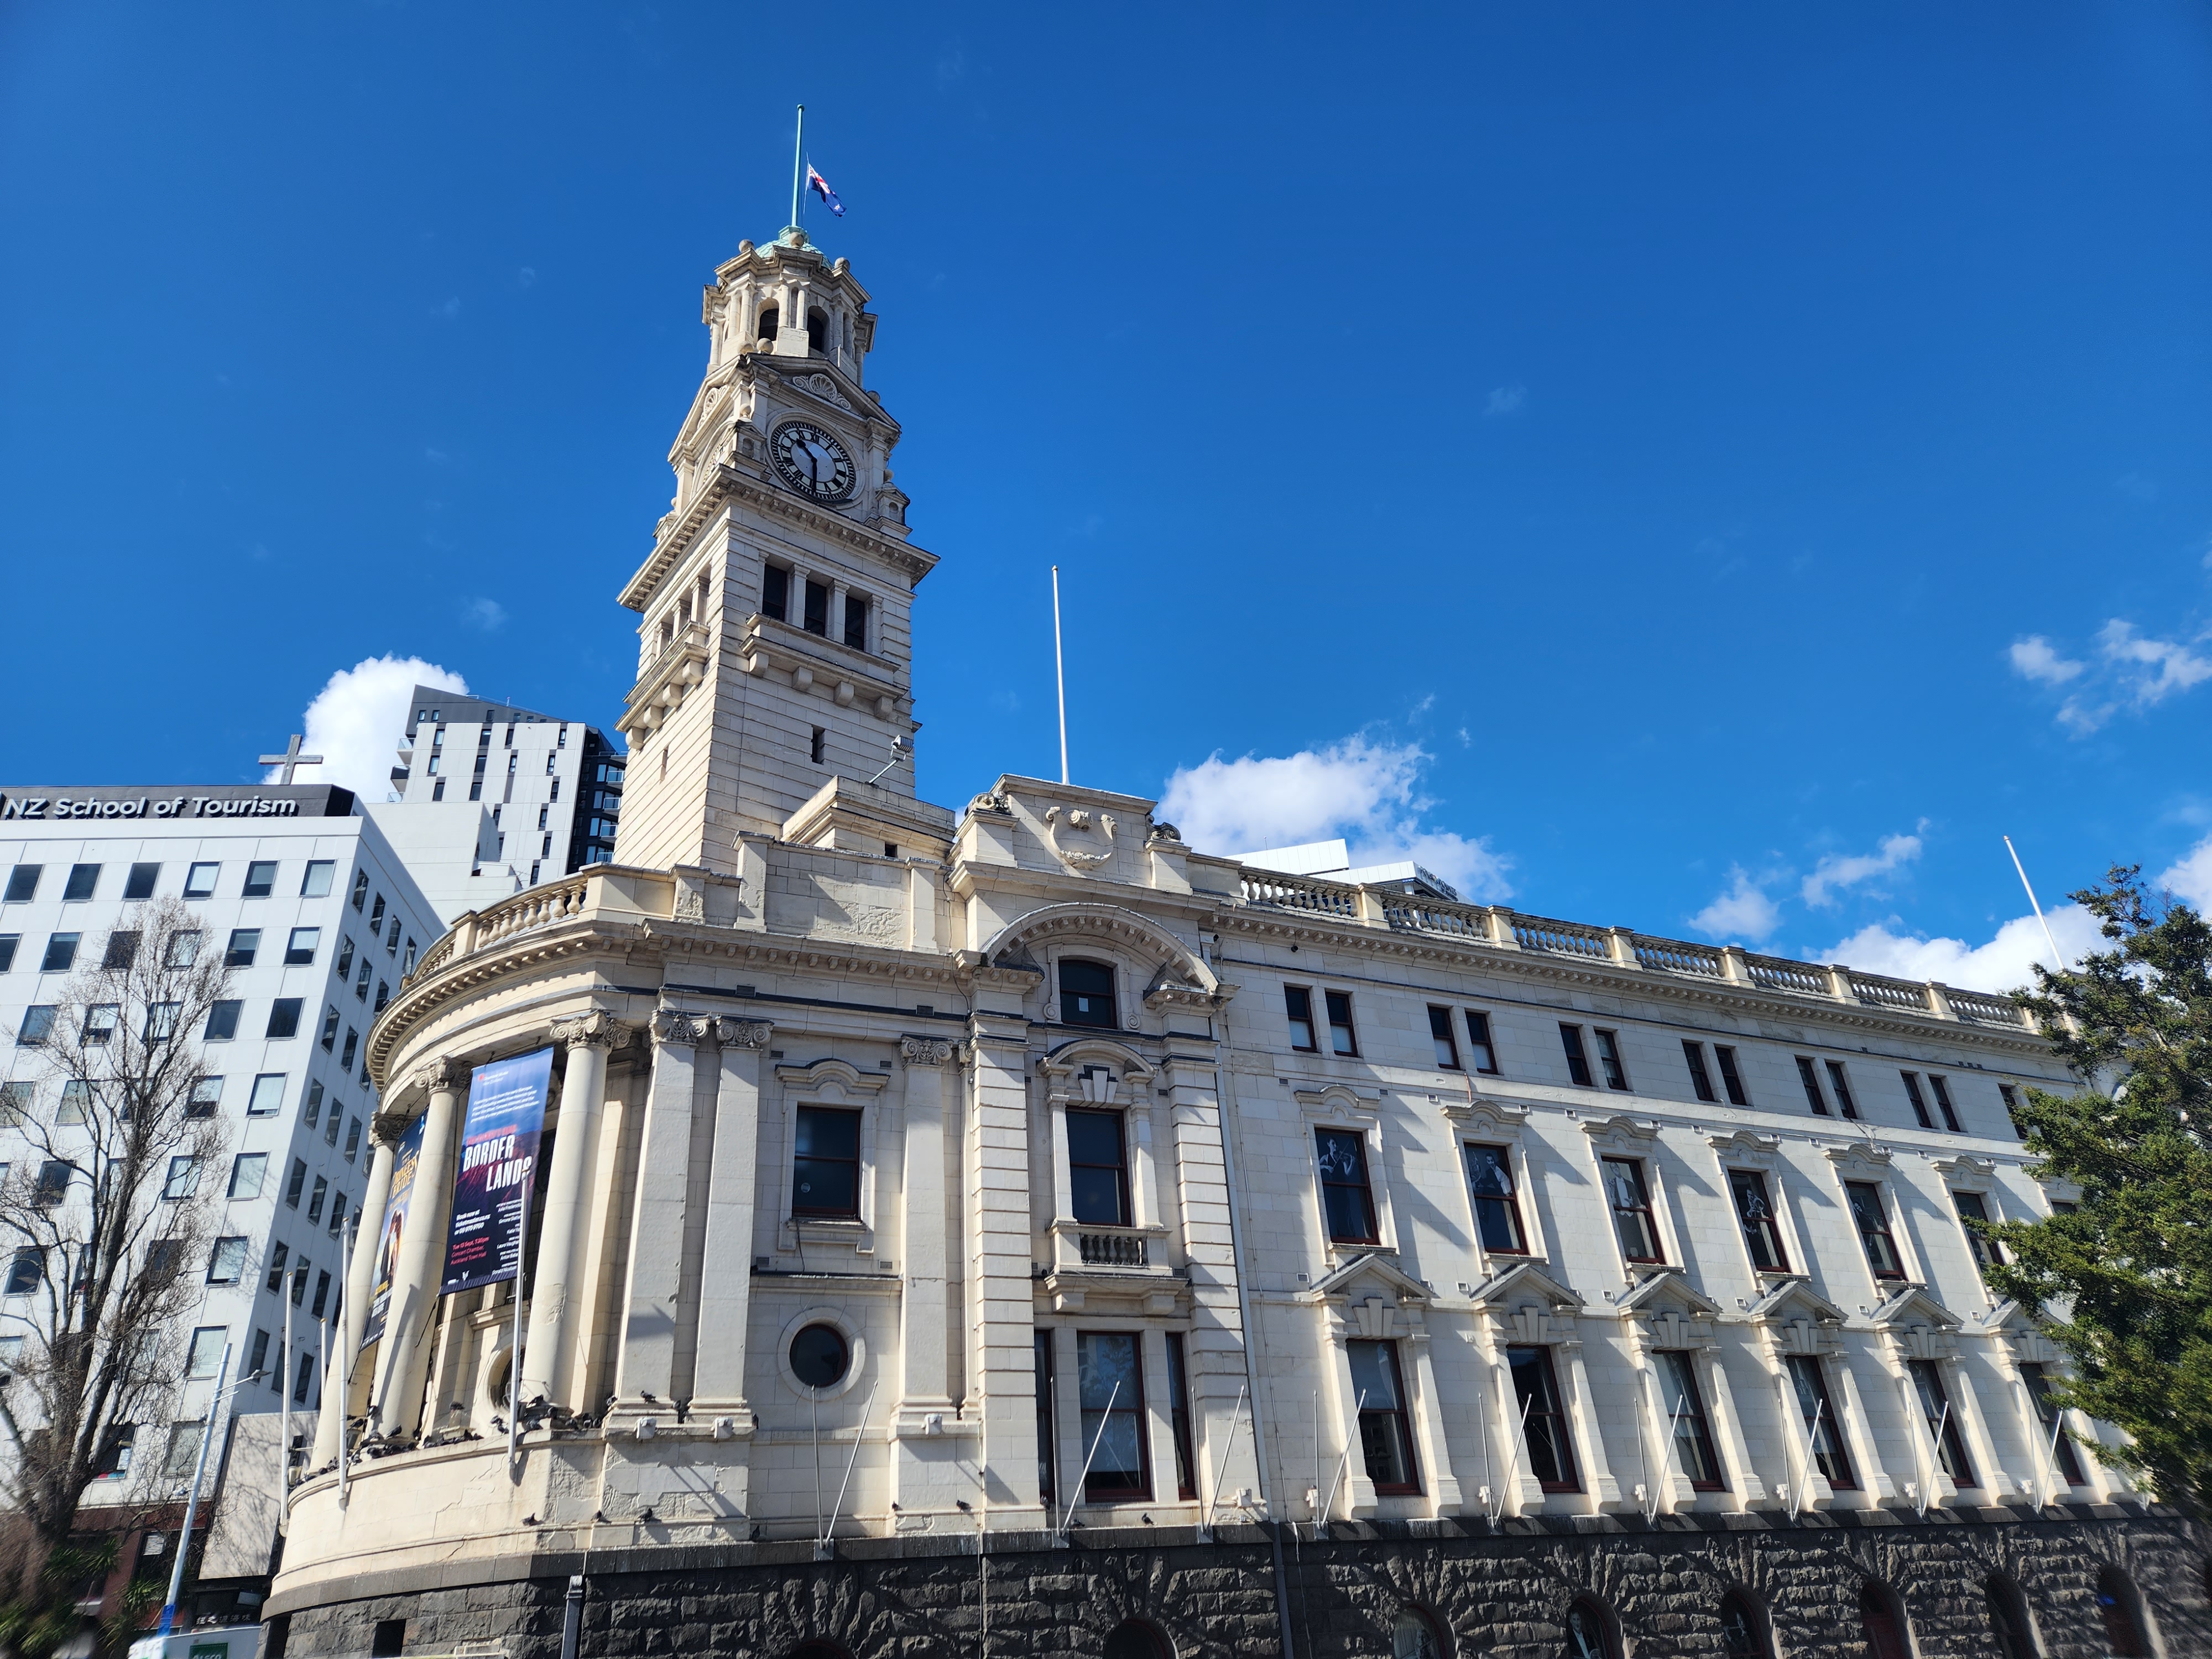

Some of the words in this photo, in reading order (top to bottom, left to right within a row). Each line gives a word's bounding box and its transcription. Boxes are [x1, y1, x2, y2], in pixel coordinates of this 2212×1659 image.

[4, 799, 46, 815] NZ
[53, 797, 147, 815] School
[153, 796, 184, 814] of
[192, 795, 296, 813] Tourism
[463, 1134, 515, 1172] BORDER
[486, 1156, 533, 1192] LANDS
